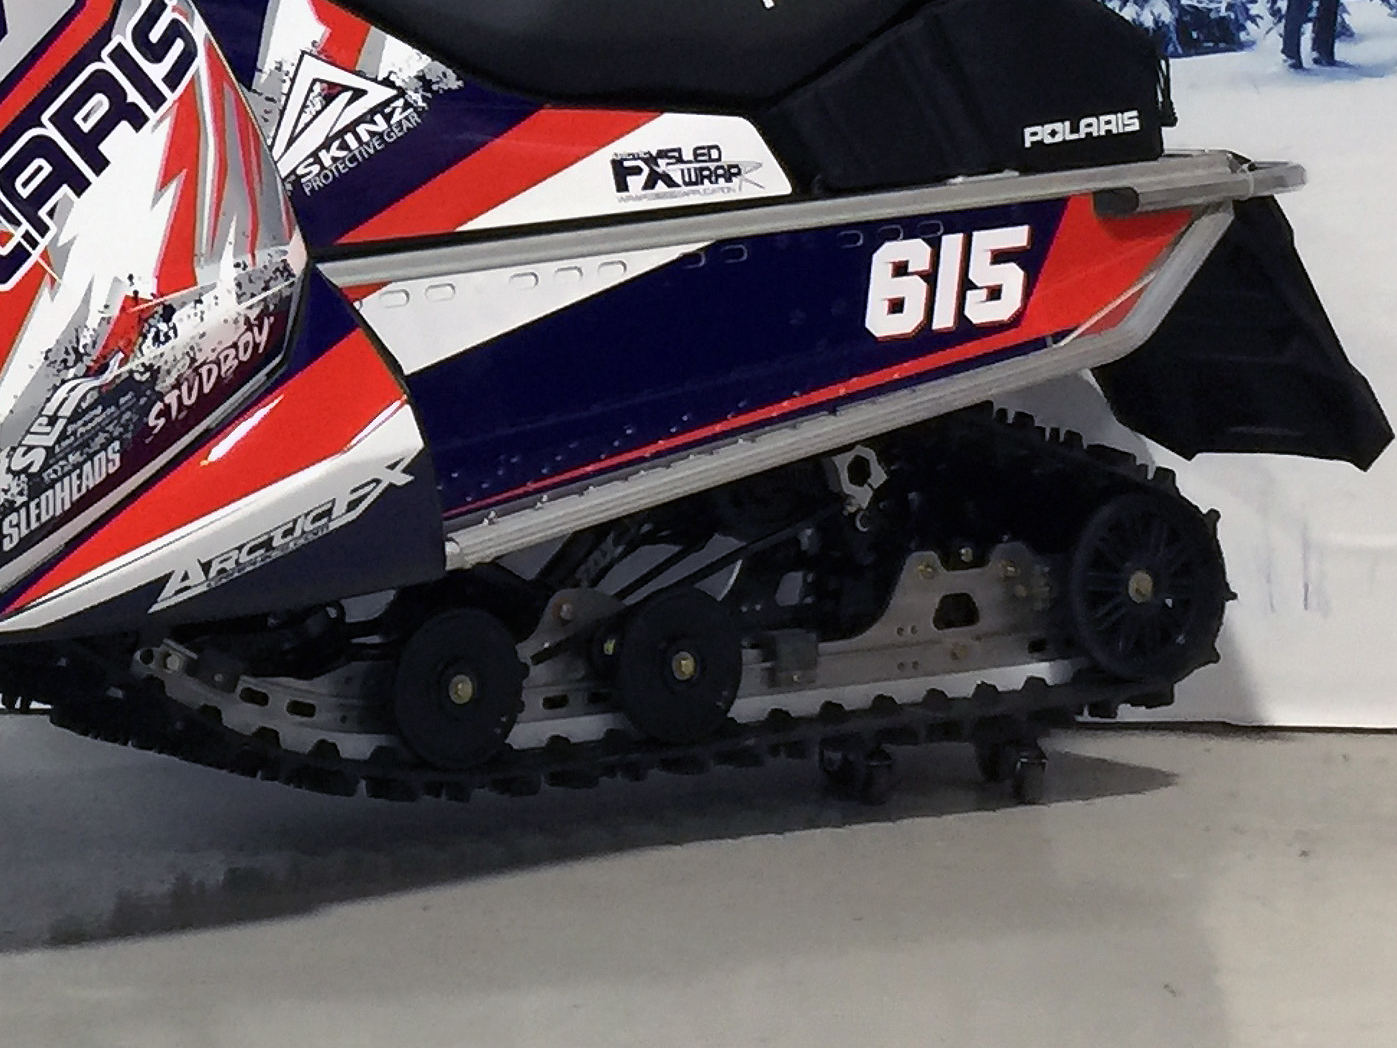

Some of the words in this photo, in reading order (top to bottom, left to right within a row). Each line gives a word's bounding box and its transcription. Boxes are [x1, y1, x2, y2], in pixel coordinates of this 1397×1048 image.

[296, 97, 414, 184] SKINZ
[302, 136, 386, 197] PROTECTIVE
[383, 112, 423, 143] GEAR
[1023, 110, 1140, 148] POLARIS
[864, 225, 1032, 341] 615
[146, 316, 272, 437] STUDBOY
[2, 440, 121, 552] SLEDHEADS
